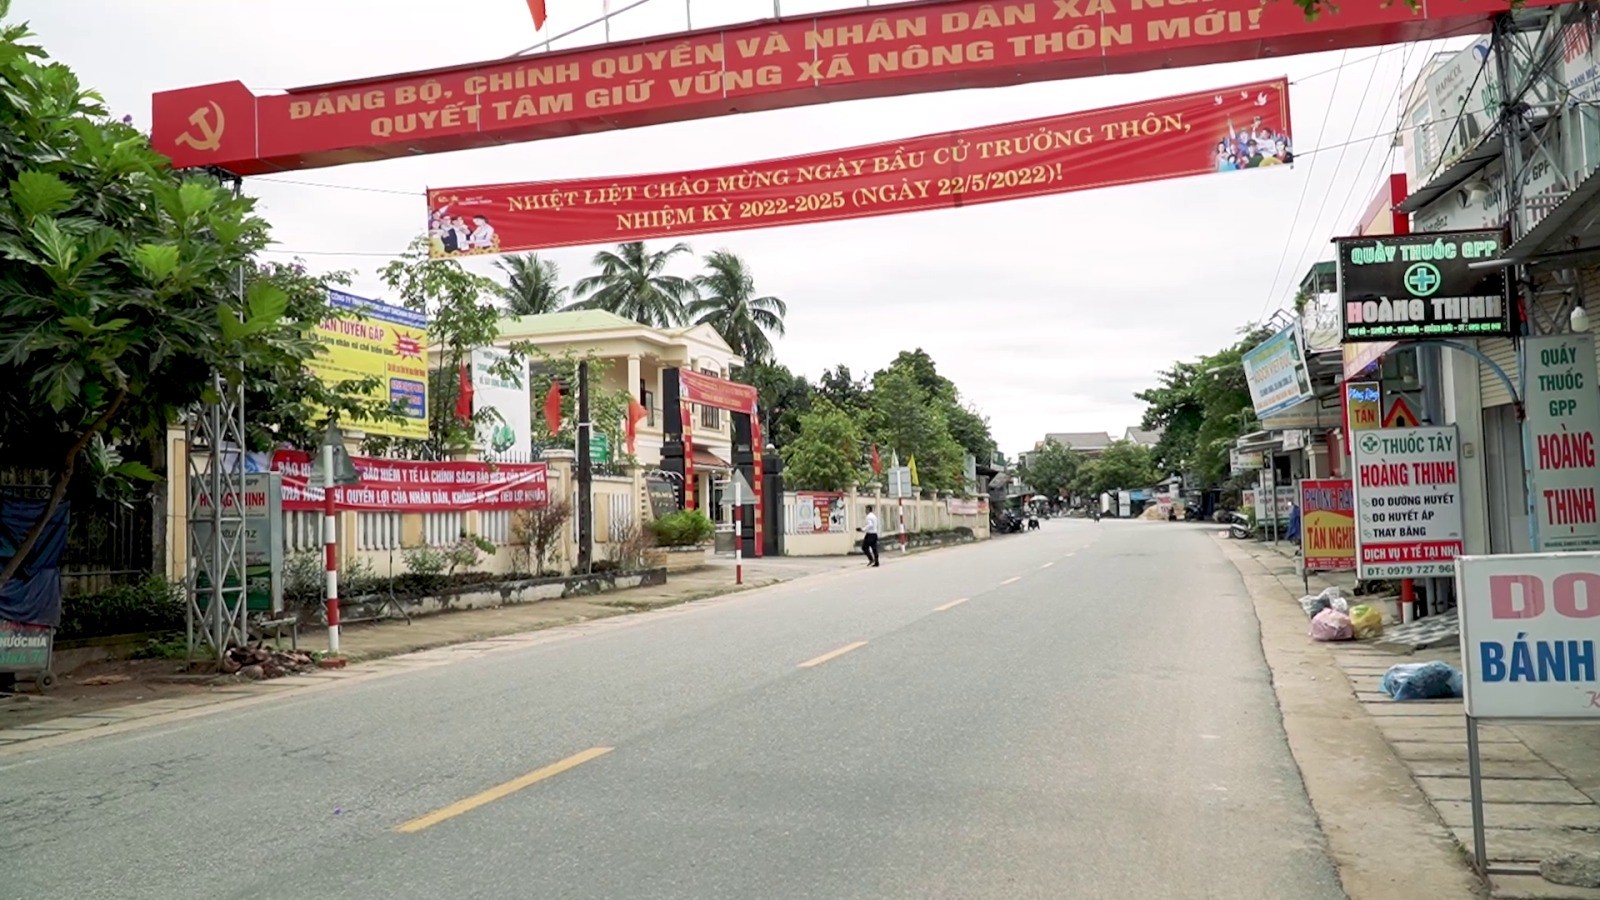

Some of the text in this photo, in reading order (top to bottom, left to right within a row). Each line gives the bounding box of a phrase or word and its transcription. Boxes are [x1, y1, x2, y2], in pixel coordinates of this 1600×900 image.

[289, 91, 385, 119] ĐẢNG
[395, 79, 452, 105] BỘ,
[464, 62, 580, 95] CHÍNH
[592, 41, 723, 79] QUYỀN
[736, 31, 790, 58] VÀ
[805, 16, 927, 50] NHÂN
[942, 3, 1036, 34] DÂN
[371, 8, 1262, 136] QUYẾT TÂM GIỮ VỮNG XÃ NÔNG THÔN MỚI!
[507, 112, 1192, 212] NHIỆT LIỆT CHÀO MỪNG NGÀY BẦU CỬ TRƯỞNG THÔN,
[616, 163, 1063, 230] NHIỆM KỲ 2022-2025 (NGÀY 22/5/2022)!
[1400, 238, 1457, 262] THUỐC
[1461, 240, 1498, 259] GPP
[1346, 295, 1503, 324] HOÀNG THỊNH
[1538, 366, 1584, 391] THUỐC
[1549, 399, 1577, 417] GPP
[1382, 431, 1453, 454] THUỐC TÂY
[1537, 423, 1595, 470] HOÀNG
[402, 468, 408, 482] Y
[409, 465, 419, 482] TẾ
[419, 467, 430, 483] LÀ
[455, 468, 476, 484] SÁCH
[1360, 458, 1456, 490] HOÀNG THỊNH
[376, 489, 390, 507] LỢI
[391, 486, 408, 504] CỦA
[409, 488, 431, 504] NHÂN
[1371, 492, 1454, 507] ĐO ĐƯỜNG HUYẾT
[1372, 508, 1435, 522] ĐO HUYẾT ÁP
[1543, 487, 1597, 533] THỊNH
[1373, 528, 1397, 538] THAY
[1364, 547, 1386, 563] DỊCH
[1388, 547, 1401, 561] VỤ
[1403, 547, 1409, 558] Y
[1410, 543, 1422, 558] TẾ
[1424, 545, 1438, 560] TẠI
[1441, 543, 1460, 557] NHÀ
[1387, 565, 1413, 575] 0979
[1417, 564, 1435, 574] 727
[1480, 632, 1596, 682] BÁNH
